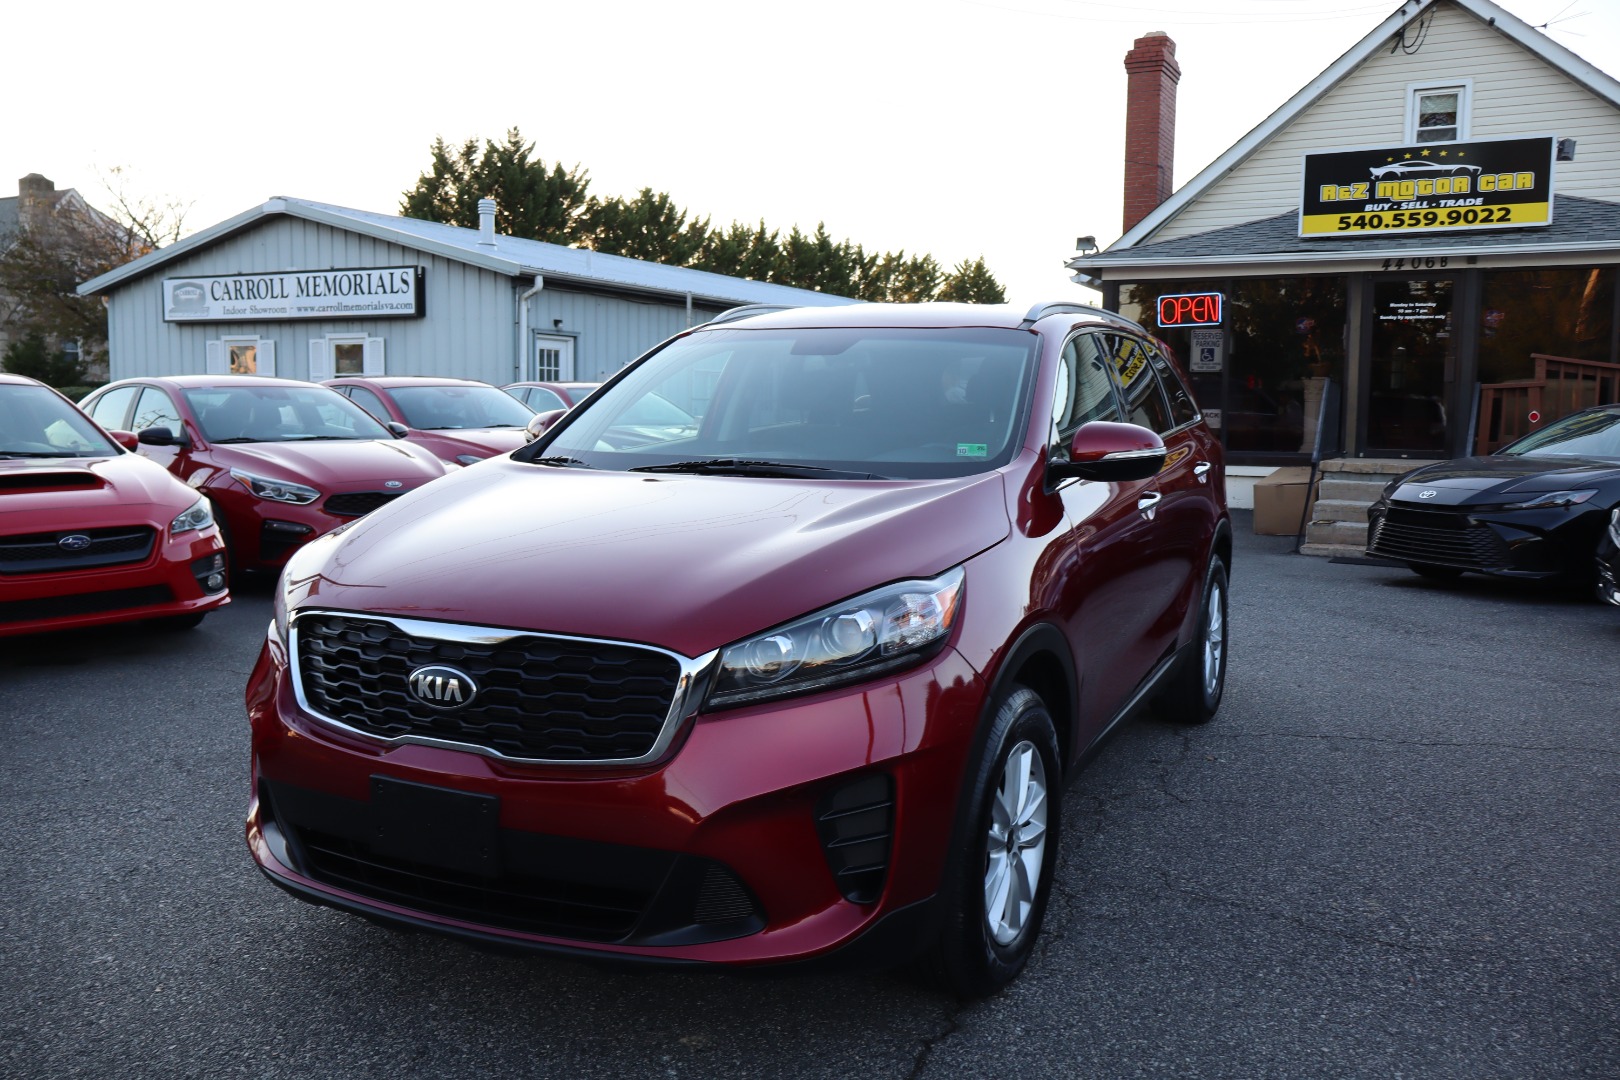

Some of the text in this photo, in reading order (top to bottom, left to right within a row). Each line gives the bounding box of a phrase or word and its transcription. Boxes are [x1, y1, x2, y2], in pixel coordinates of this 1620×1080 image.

[1364, 197, 1484, 212] BUY SELL TRADE
[1338, 207, 1511, 230] 540.559.9022
[210, 271, 410, 301] CARROLL MEMORIALS
[223, 306, 247, 315] Indoor
[249, 305, 288, 314] Showroom
[296, 301, 413, 312] www.carrollmemorialsva.com
[1160, 295, 1219, 324] OPEN
[1193, 332, 1223, 340] RESERVED
[417, 674, 463, 702] KIA
